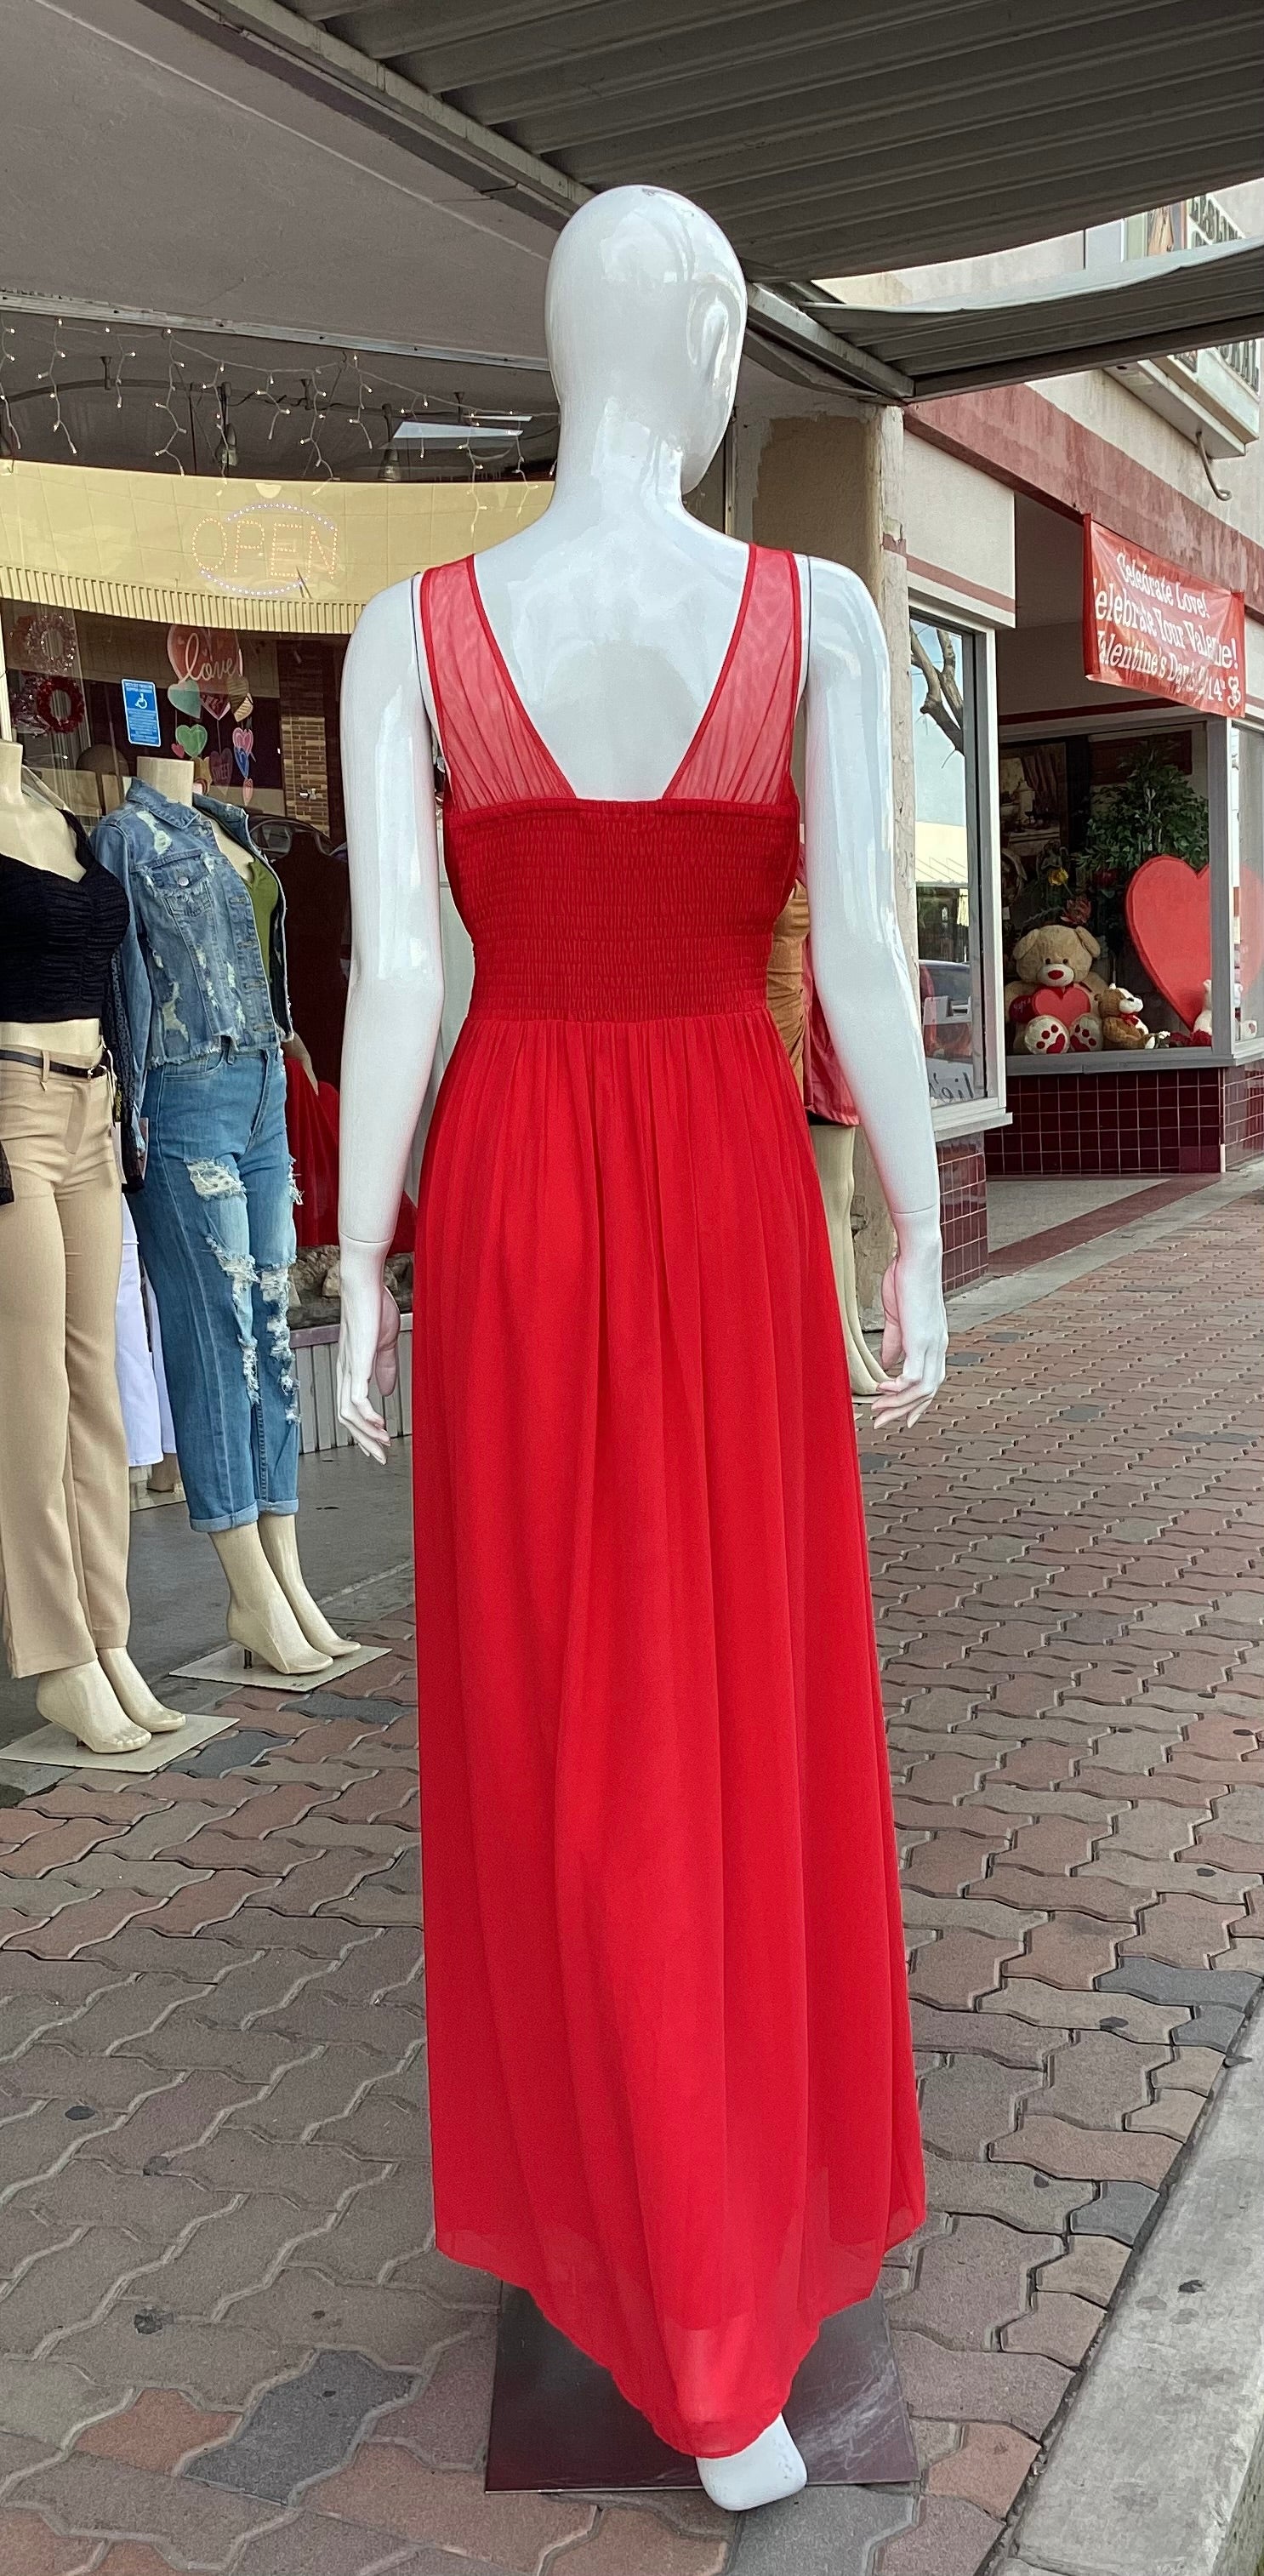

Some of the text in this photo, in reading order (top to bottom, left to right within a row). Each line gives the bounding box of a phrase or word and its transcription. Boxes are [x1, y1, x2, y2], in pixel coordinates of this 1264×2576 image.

[192, 516, 338, 580] OPEN
[1116, 552, 1210, 619] Celebrate Love!
[1093, 578, 1238, 670] elebrate Your Valee!
[178, 633, 237, 685] love
